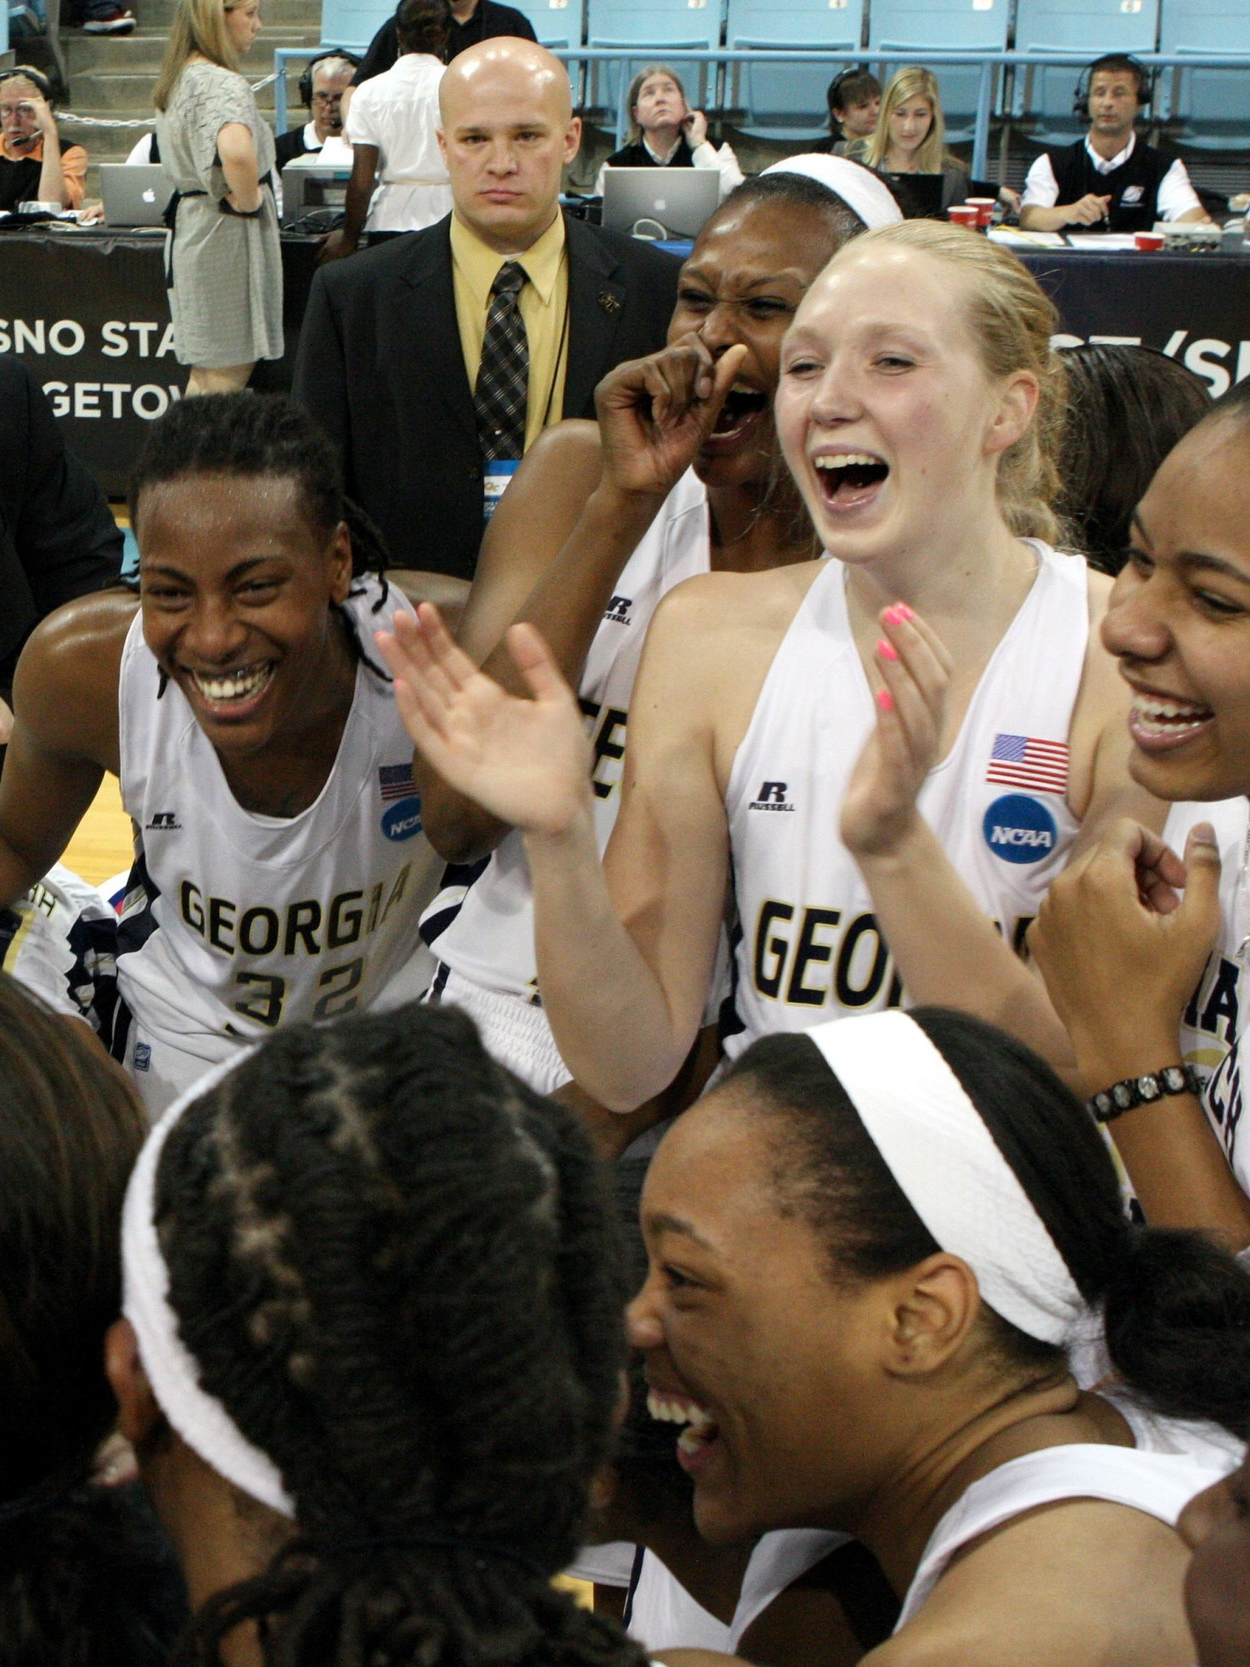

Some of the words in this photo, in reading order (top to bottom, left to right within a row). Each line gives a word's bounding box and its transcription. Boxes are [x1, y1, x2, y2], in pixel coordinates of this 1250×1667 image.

[748, 802, 796, 812] RUSSELL
[990, 825, 1052, 848] NCAA
[180, 861, 412, 956] GEORGIA
